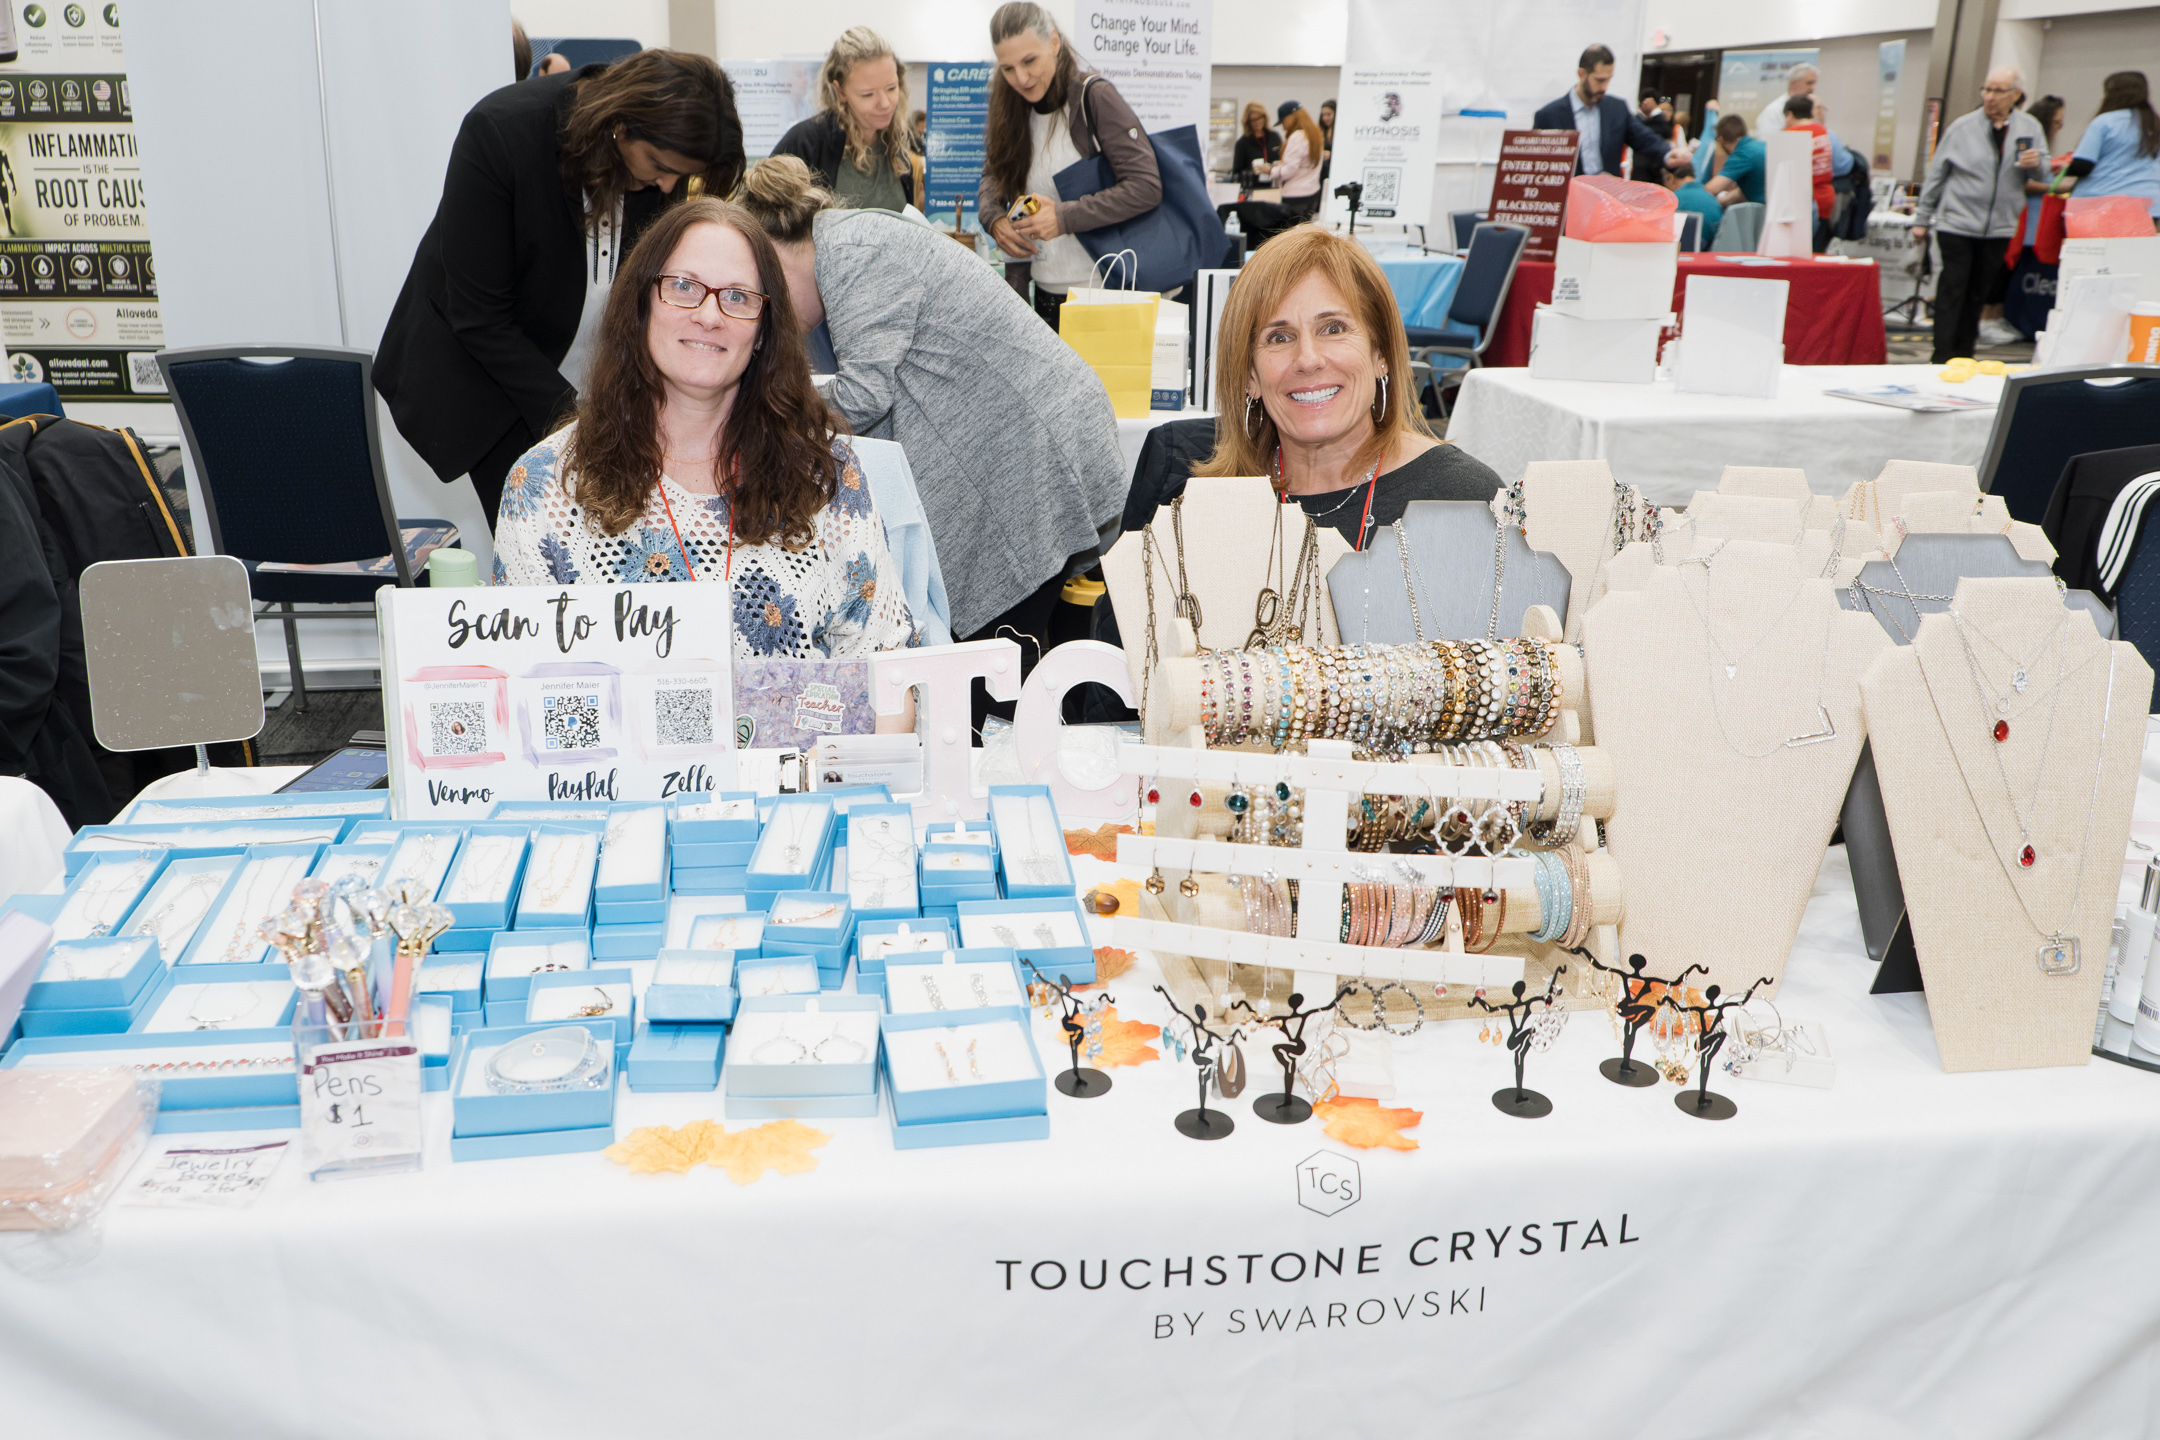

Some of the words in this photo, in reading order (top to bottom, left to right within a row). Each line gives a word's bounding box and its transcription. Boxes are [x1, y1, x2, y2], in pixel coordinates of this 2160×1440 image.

[1091, 13, 1136, 35] Change
[1140, 16, 1167, 33] Your
[1170, 18, 1202, 35] Mind.
[1094, 35, 1140, 56] Change
[1144, 37, 1171, 54] Your
[1174, 39, 1200, 56] Life.
[1103, 68, 1132, 78] Hypnosis
[1133, 69, 1184, 79] Demonstrations
[1185, 70, 1203, 82] Today
[1355, 126, 1421, 136] HYPNOSIS
[1503, 146, 1551, 155] MANAGEMENT
[1552, 146, 1577, 155] GROUP
[83, 164, 92, 174] IS
[93, 164, 110, 174] THE
[1501, 160, 1533, 172] ENTER
[1534, 161, 1549, 172] TO
[1549, 161, 1571, 173] WIN
[1502, 173, 1511, 184] A
[1511, 173, 1535, 185] GIFT
[1535, 175, 1565, 186] CARD
[35, 179, 89, 208] ROOT
[1523, 187, 1539, 198] TO
[1496, 199, 1561, 212] BLACKSTONE
[64, 214, 79, 227] OF
[84, 214, 145, 227] PROBLEM.
[1494, 212, 1559, 227] STEAKHOUSE
[0, 243, 43, 254] LAMMATION
[45, 243, 71, 254] IMPACT
[72, 243, 99, 254] ACROSS
[99, 243, 131, 254] MULTIPLE
[116, 308, 158, 319] Alloveda
[86, 371, 119, 379] inflammation.
[87, 379, 98, 387] your
[448, 599, 540, 649] Scan
[546, 591, 598, 654] to
[614, 589, 682, 659] Pay
[423, 680, 488, 691] @JenniferMaier12
[540, 681, 574, 692] Jennifer
[575, 680, 601, 691] Maier
[656, 676, 709, 686] 516-330-6605
[805, 690, 840, 700] EDUCATION
[810, 684, 837, 694] SPECIAL
[797, 696, 844, 713] Teacher
[548, 767, 620, 801] PayPal
[661, 764, 717, 799] Zelle
[428, 779, 495, 806] Venmo
[313, 1065, 383, 1099] Pens
[156, 1156, 258, 1170] Jewelry
[178, 1170, 249, 1182] Boxes
[1304, 1166, 1353, 1201] TCS
[996, 1244, 1382, 1291] TOUCHSTONE
[1408, 1213, 1640, 1267] CRYSTAL
[1154, 1311, 1204, 1339] BY
[1227, 1285, 1487, 1334] SWAROVSKI
